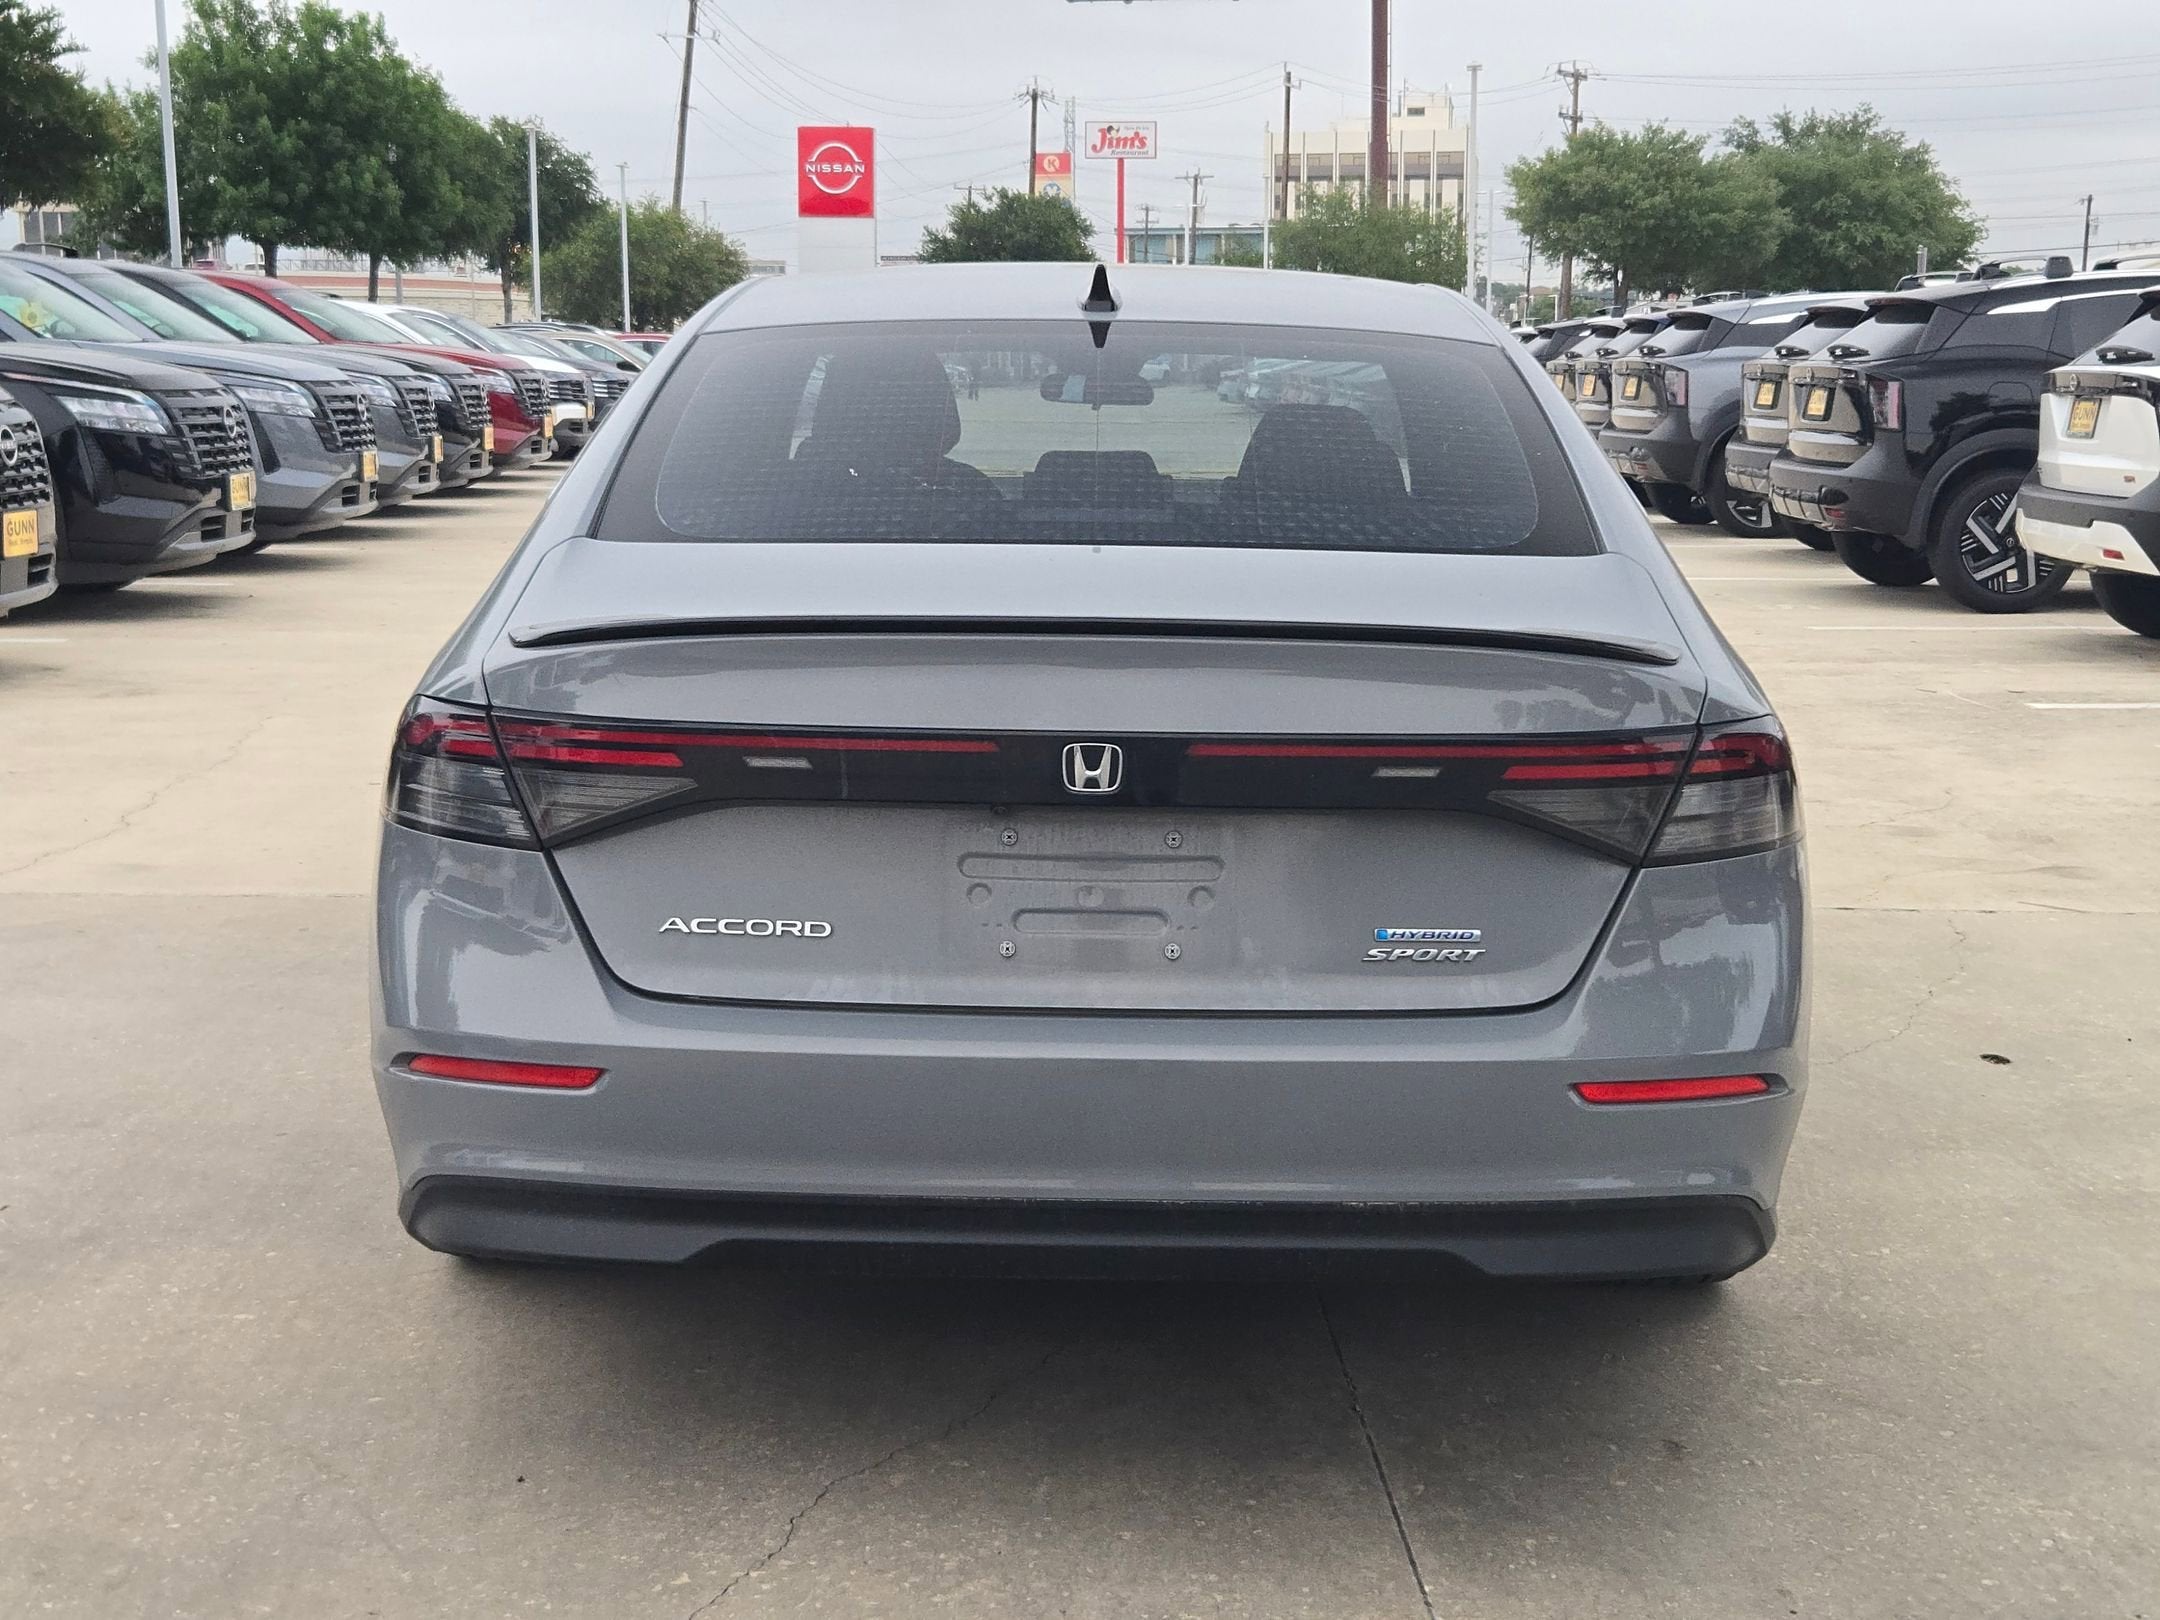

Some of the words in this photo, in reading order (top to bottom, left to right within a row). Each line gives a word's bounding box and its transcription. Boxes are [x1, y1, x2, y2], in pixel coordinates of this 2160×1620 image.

[1091, 127, 1148, 154] Jim's
[805, 164, 865, 173] NISSAN
[6, 519, 35, 537] GUNN
[658, 917, 832, 937] ACCORD
[1391, 930, 1475, 940] HYBRID
[1362, 948, 1486, 961] SPORT
